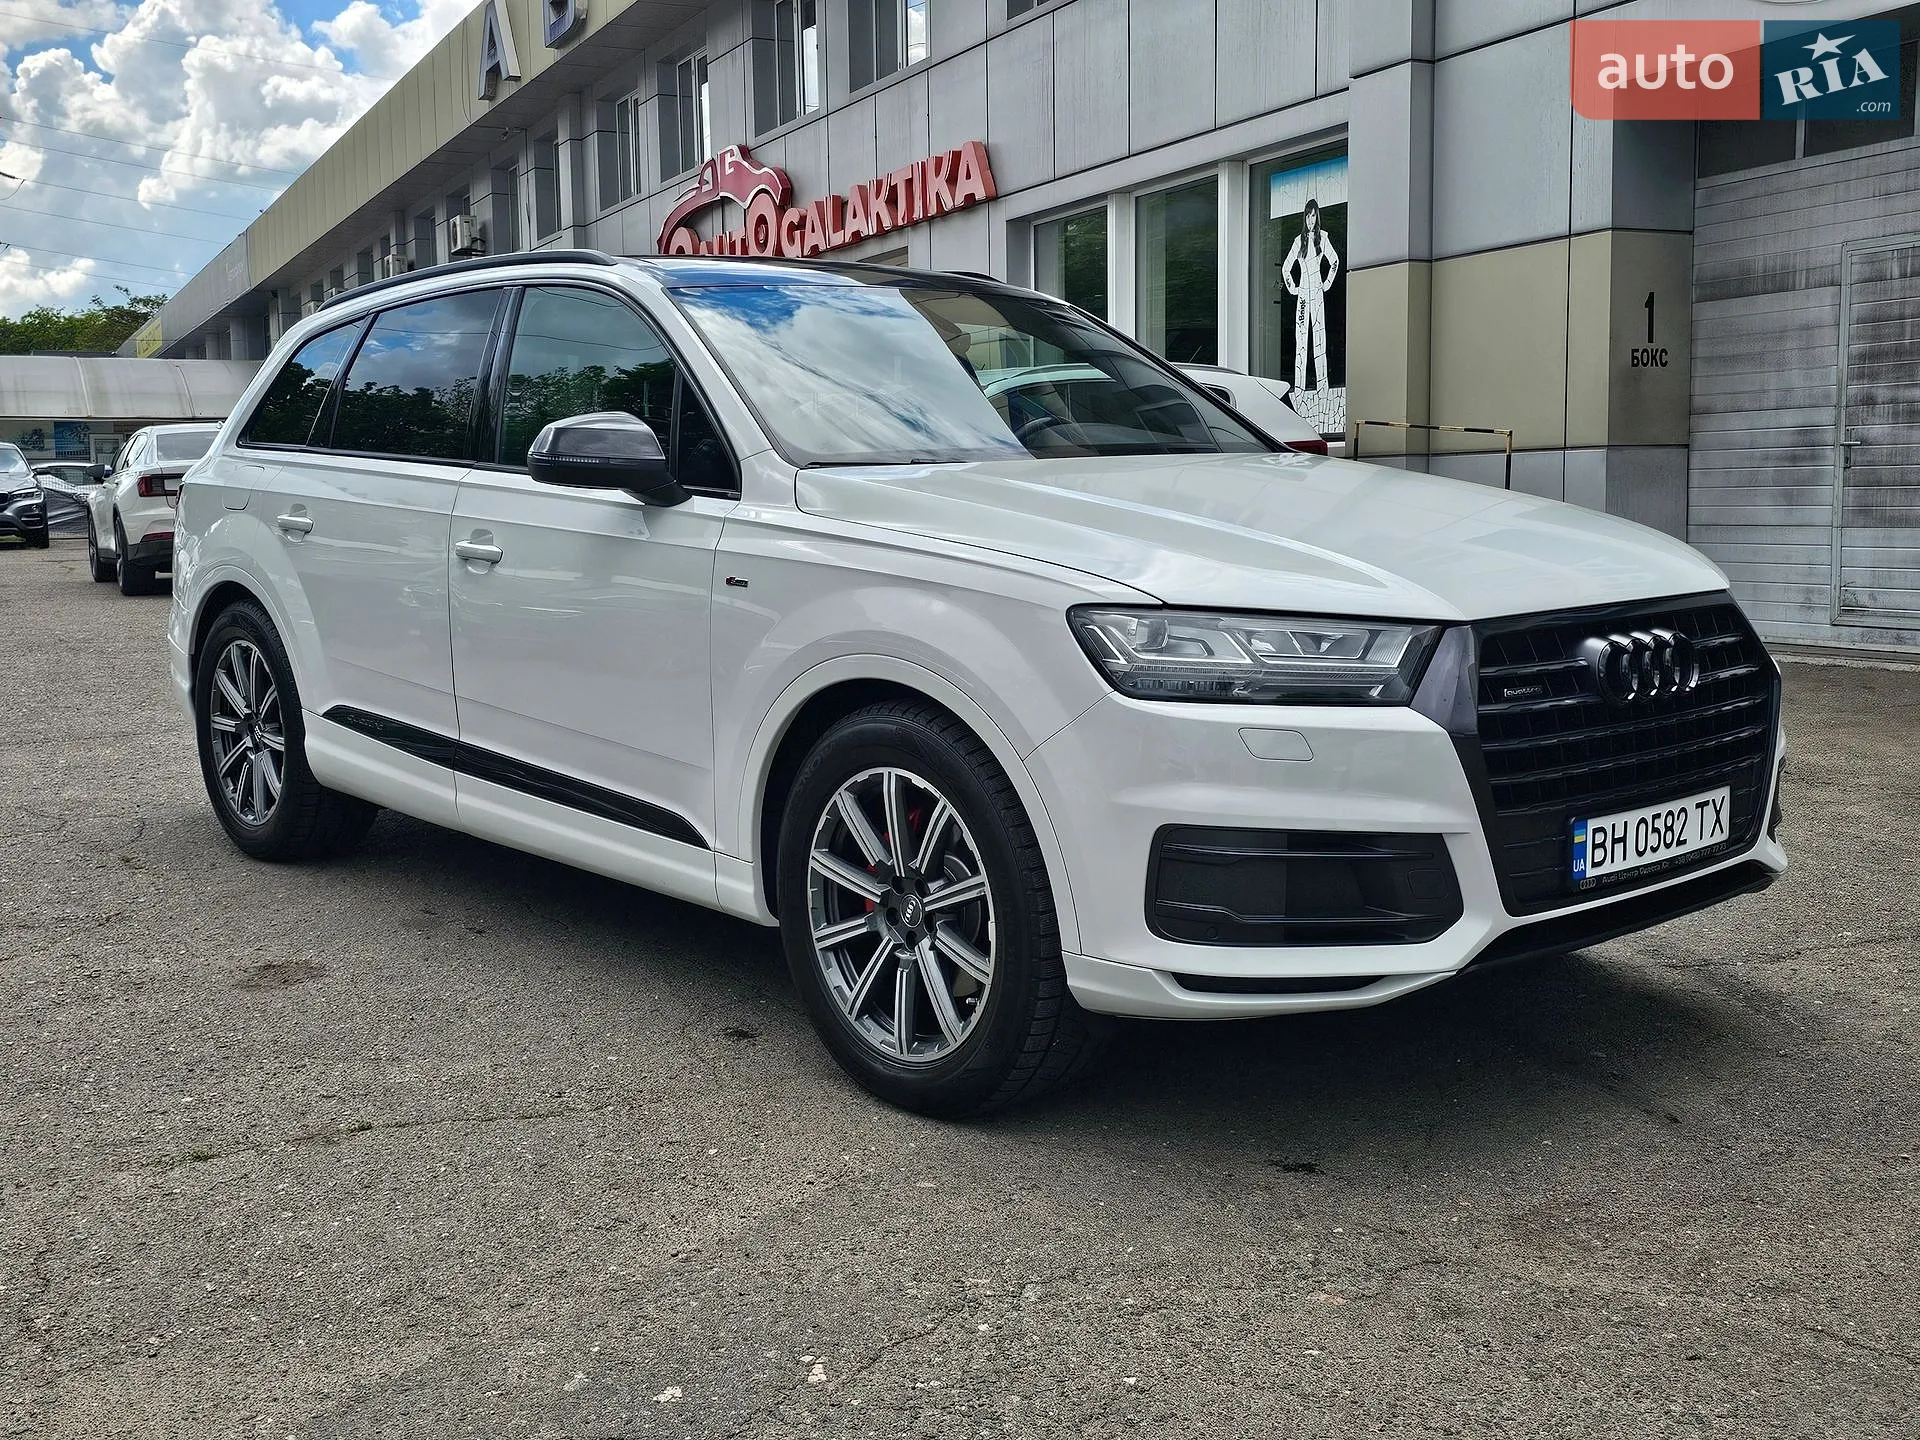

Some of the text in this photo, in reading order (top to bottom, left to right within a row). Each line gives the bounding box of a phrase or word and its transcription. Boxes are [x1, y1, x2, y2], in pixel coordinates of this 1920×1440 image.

[1644, 291, 1655, 344] 1
[1631, 347, 1668, 368] БОКС
[1590, 795, 1726, 869] BH 0582 TX
[1573, 862, 1585, 872] UA
